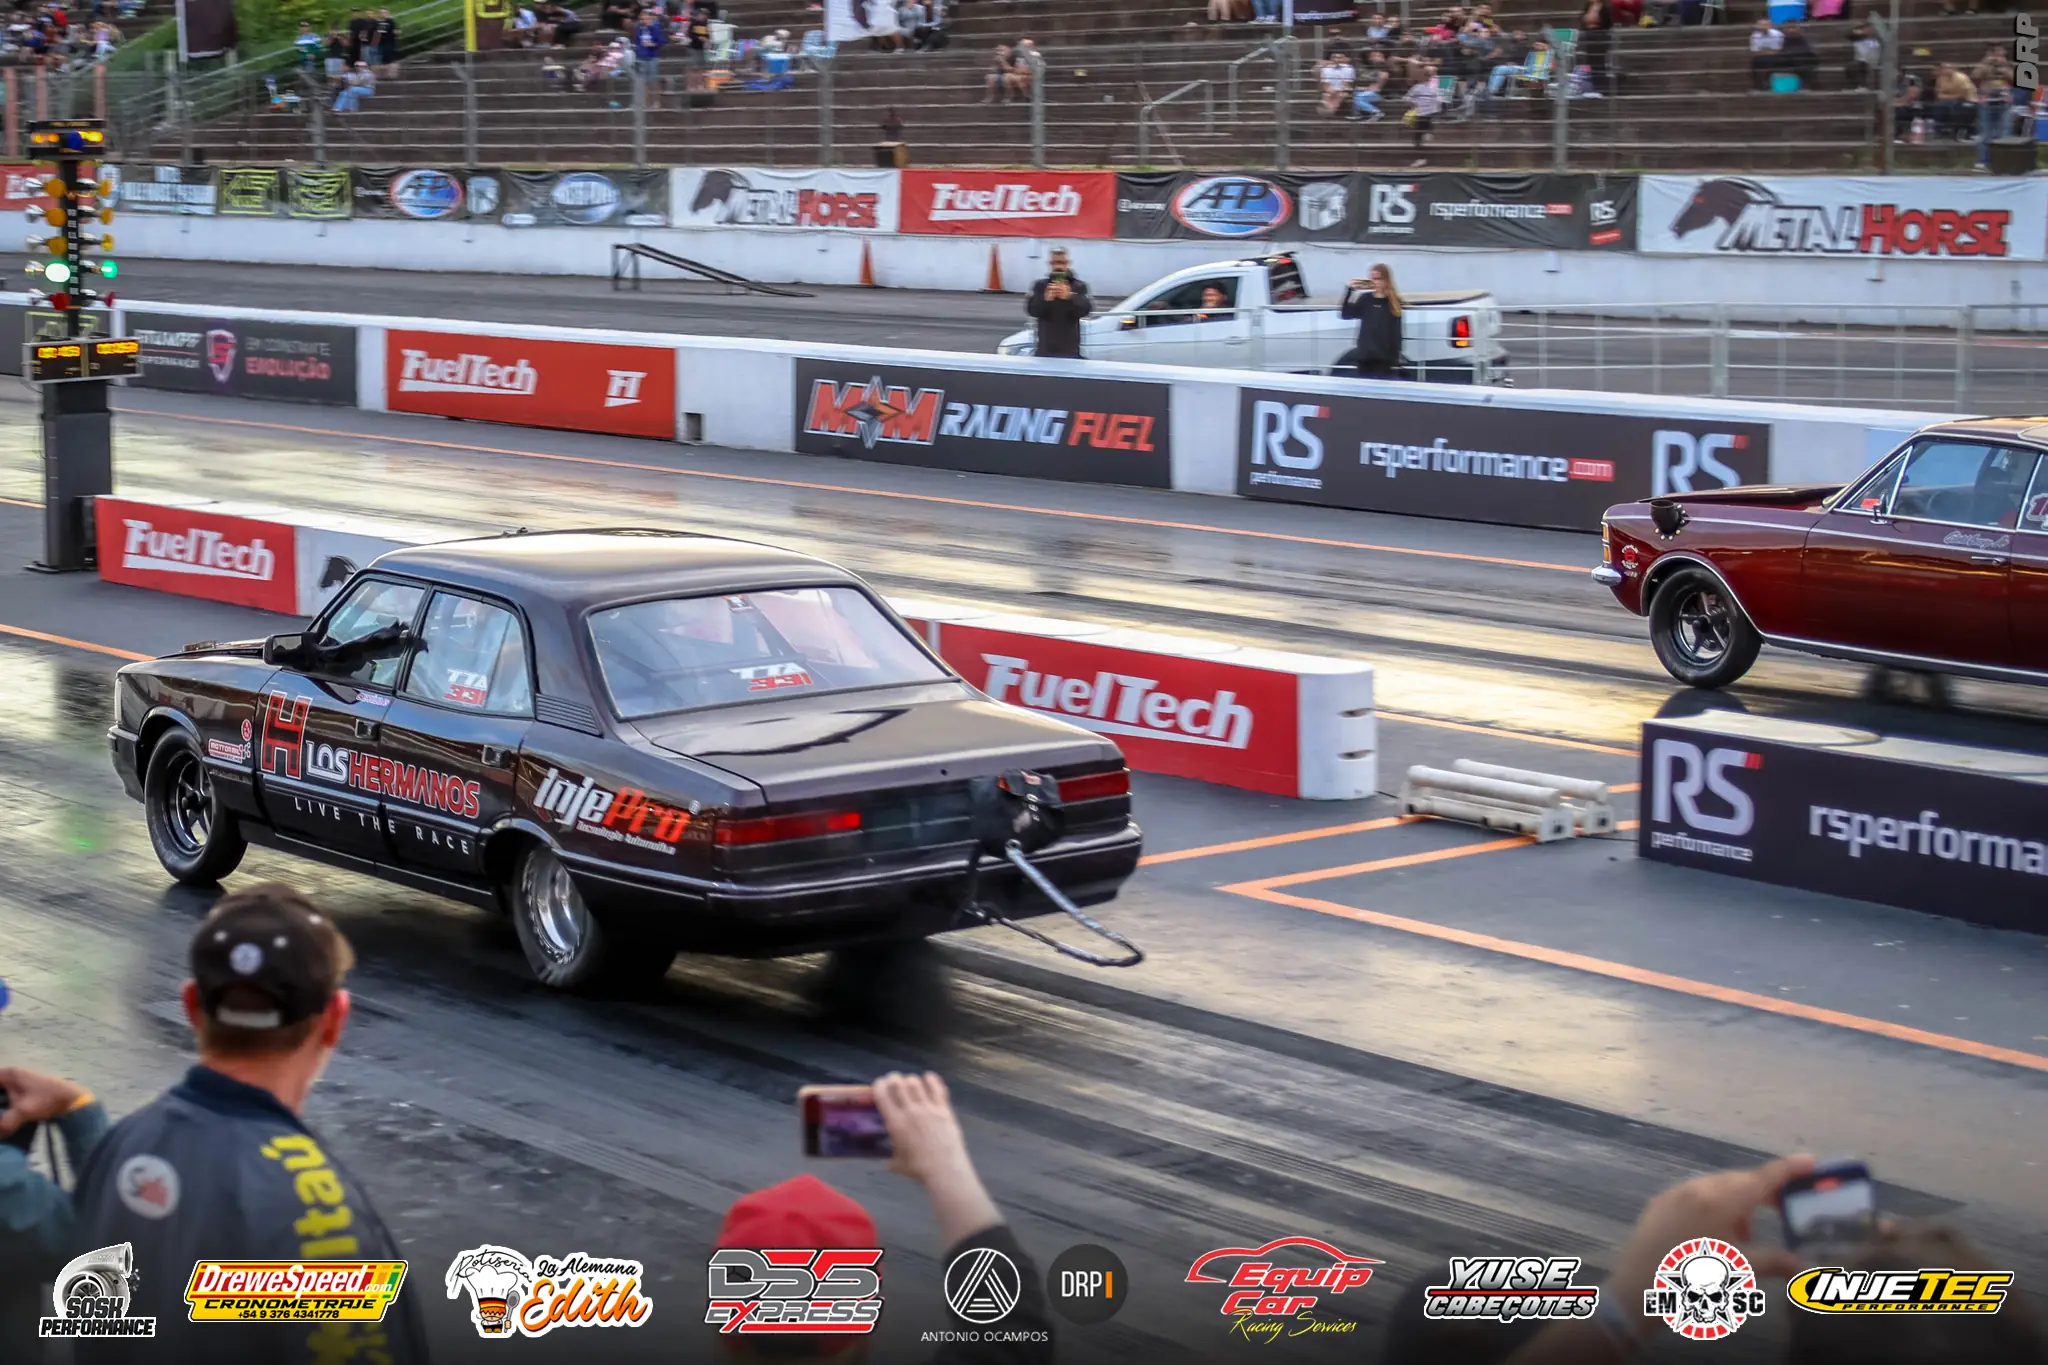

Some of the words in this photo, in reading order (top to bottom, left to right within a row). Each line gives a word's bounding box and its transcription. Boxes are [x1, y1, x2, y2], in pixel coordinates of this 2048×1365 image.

[931, 183, 1081, 220] FuelTech
[1369, 184, 1418, 223] RS
[399, 349, 538, 394] FuelTech
[939, 402, 1069, 445] RACING
[1067, 411, 1155, 453] FUEL
[1252, 400, 1330, 470] RS
[1652, 430, 1750, 497] RS
[122, 519, 275, 580] FuelTech
[980, 653, 1254, 749] FuelTech
[1652, 738, 1764, 836] RS
[294, 796, 341, 821] LIVE
[358, 812, 396, 834] THE
[415, 825, 470, 856] RACE
[1651, 831, 1754, 862] performance
